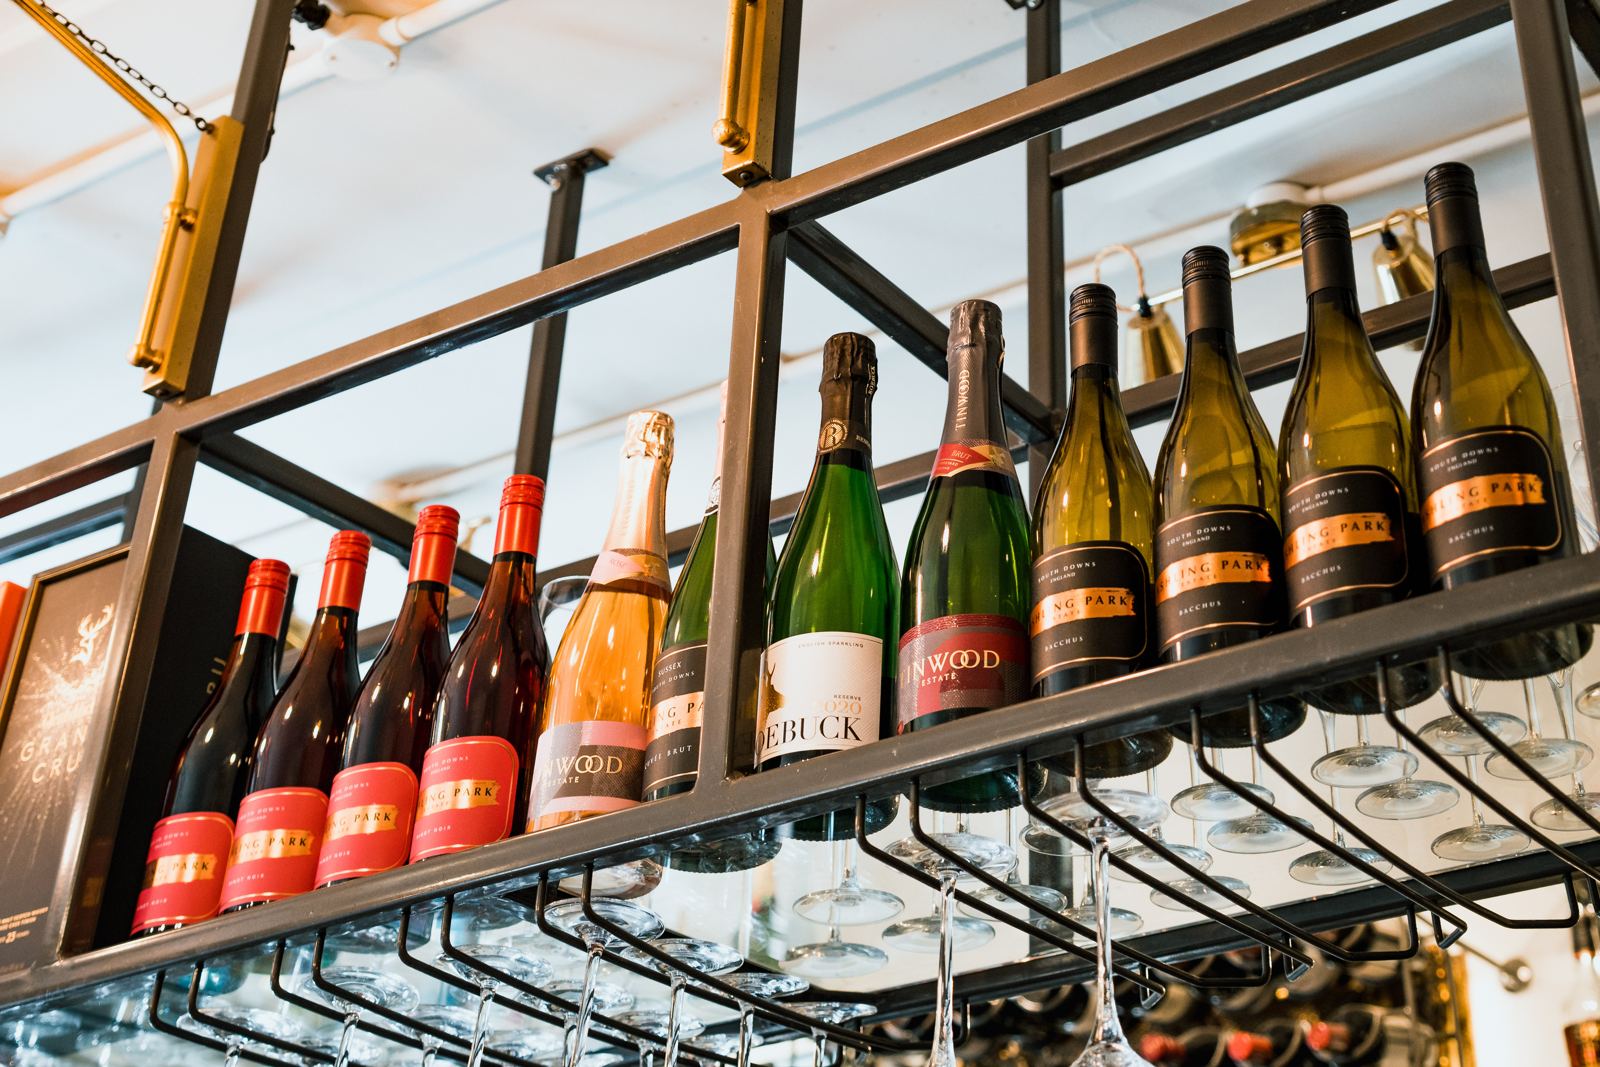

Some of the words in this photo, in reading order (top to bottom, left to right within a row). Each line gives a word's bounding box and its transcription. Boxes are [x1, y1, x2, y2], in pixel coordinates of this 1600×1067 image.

[951, 449, 972, 461] BRUT
[1430, 455, 1457, 473] SOUTH
[1461, 446, 1499, 459] DOWNS
[1491, 482, 1537, 493] PARK
[1288, 498, 1311, 513] SOUTH
[1315, 487, 1349, 499] DOWNS
[1340, 521, 1386, 533] PARK
[1166, 532, 1192, 547] SOUTH
[1196, 525, 1231, 536] DOWNS
[1449, 525, 1494, 544] BACCHUS
[1221, 559, 1264, 571] PARK
[1038, 568, 1059, 583] SOUTH
[1063, 561, 1096, 572] DOWNS
[1050, 572, 1076, 584] ENGLAND
[1301, 564, 1342, 584] BACCHUS
[1085, 595, 1129, 606] PARK
[1178, 600, 1222, 616] BACCHUS
[1044, 636, 1084, 652] BACCHUS
[658, 661, 682, 678] SUSSEX
[668, 671, 695, 682] DOWNS
[921, 672, 957, 687] ESTATE
[20, 724, 89, 762] GRAN
[667, 745, 692, 757] BRUT
[31, 751, 81, 784] CRU
[454, 786, 493, 797] PARK
[354, 811, 392, 822] PARK
[269, 837, 307, 847] PARK
[172, 862, 209, 871] PARK
